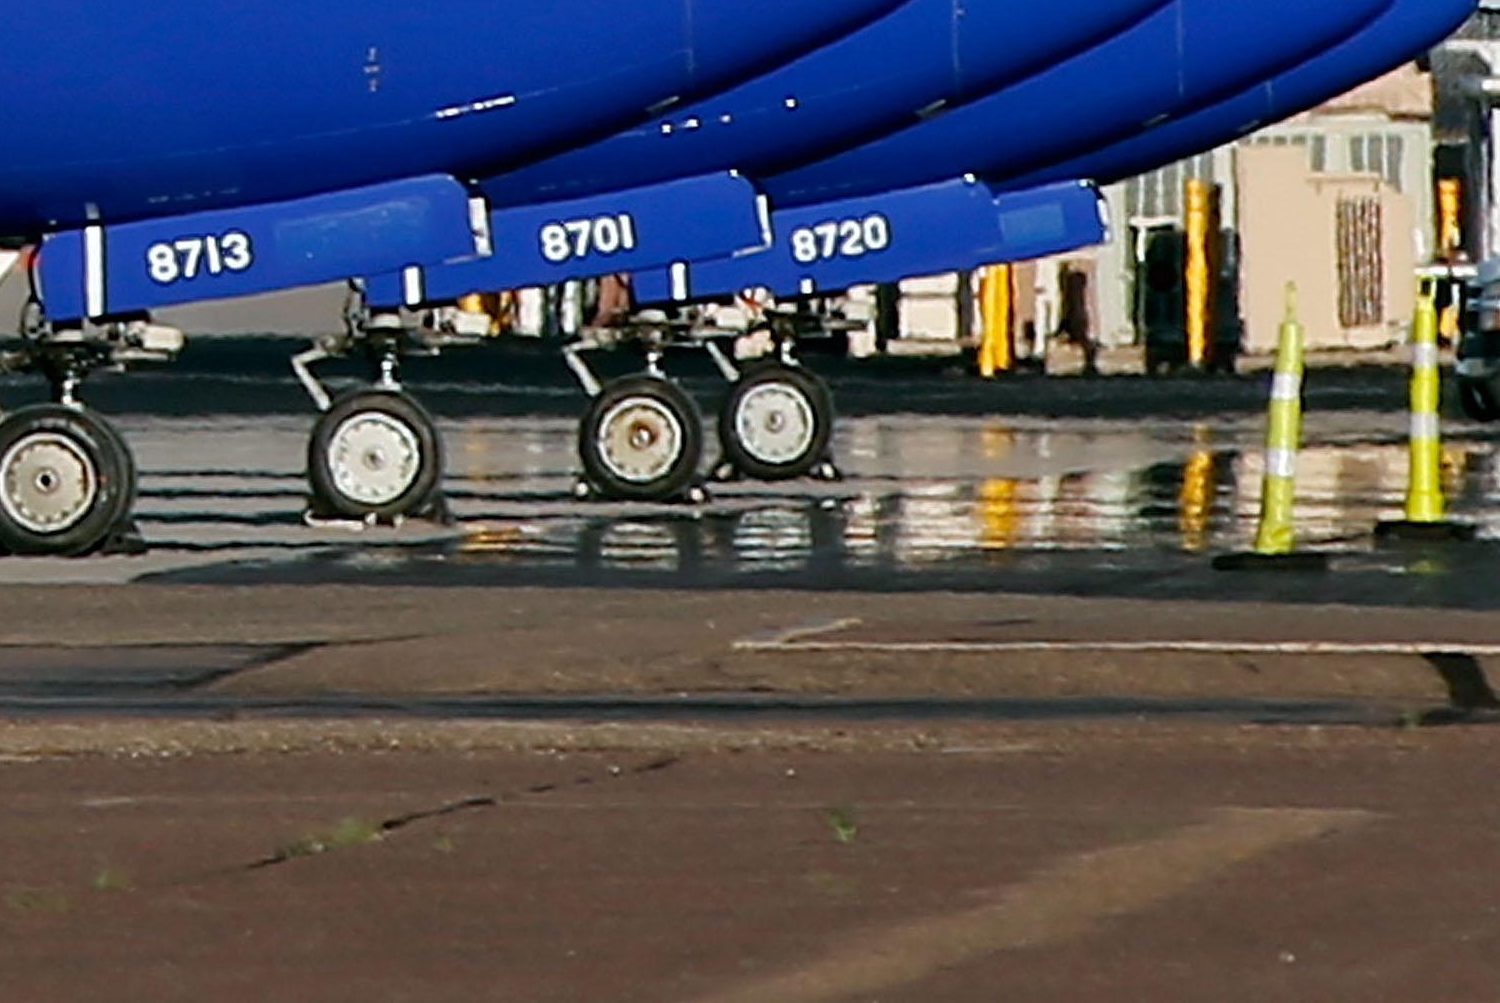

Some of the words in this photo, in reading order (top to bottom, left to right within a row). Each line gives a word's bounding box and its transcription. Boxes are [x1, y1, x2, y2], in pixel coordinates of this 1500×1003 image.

[147, 232, 253, 283] 8713
[540, 214, 635, 261] 8701
[791, 215, 889, 262] 8720
